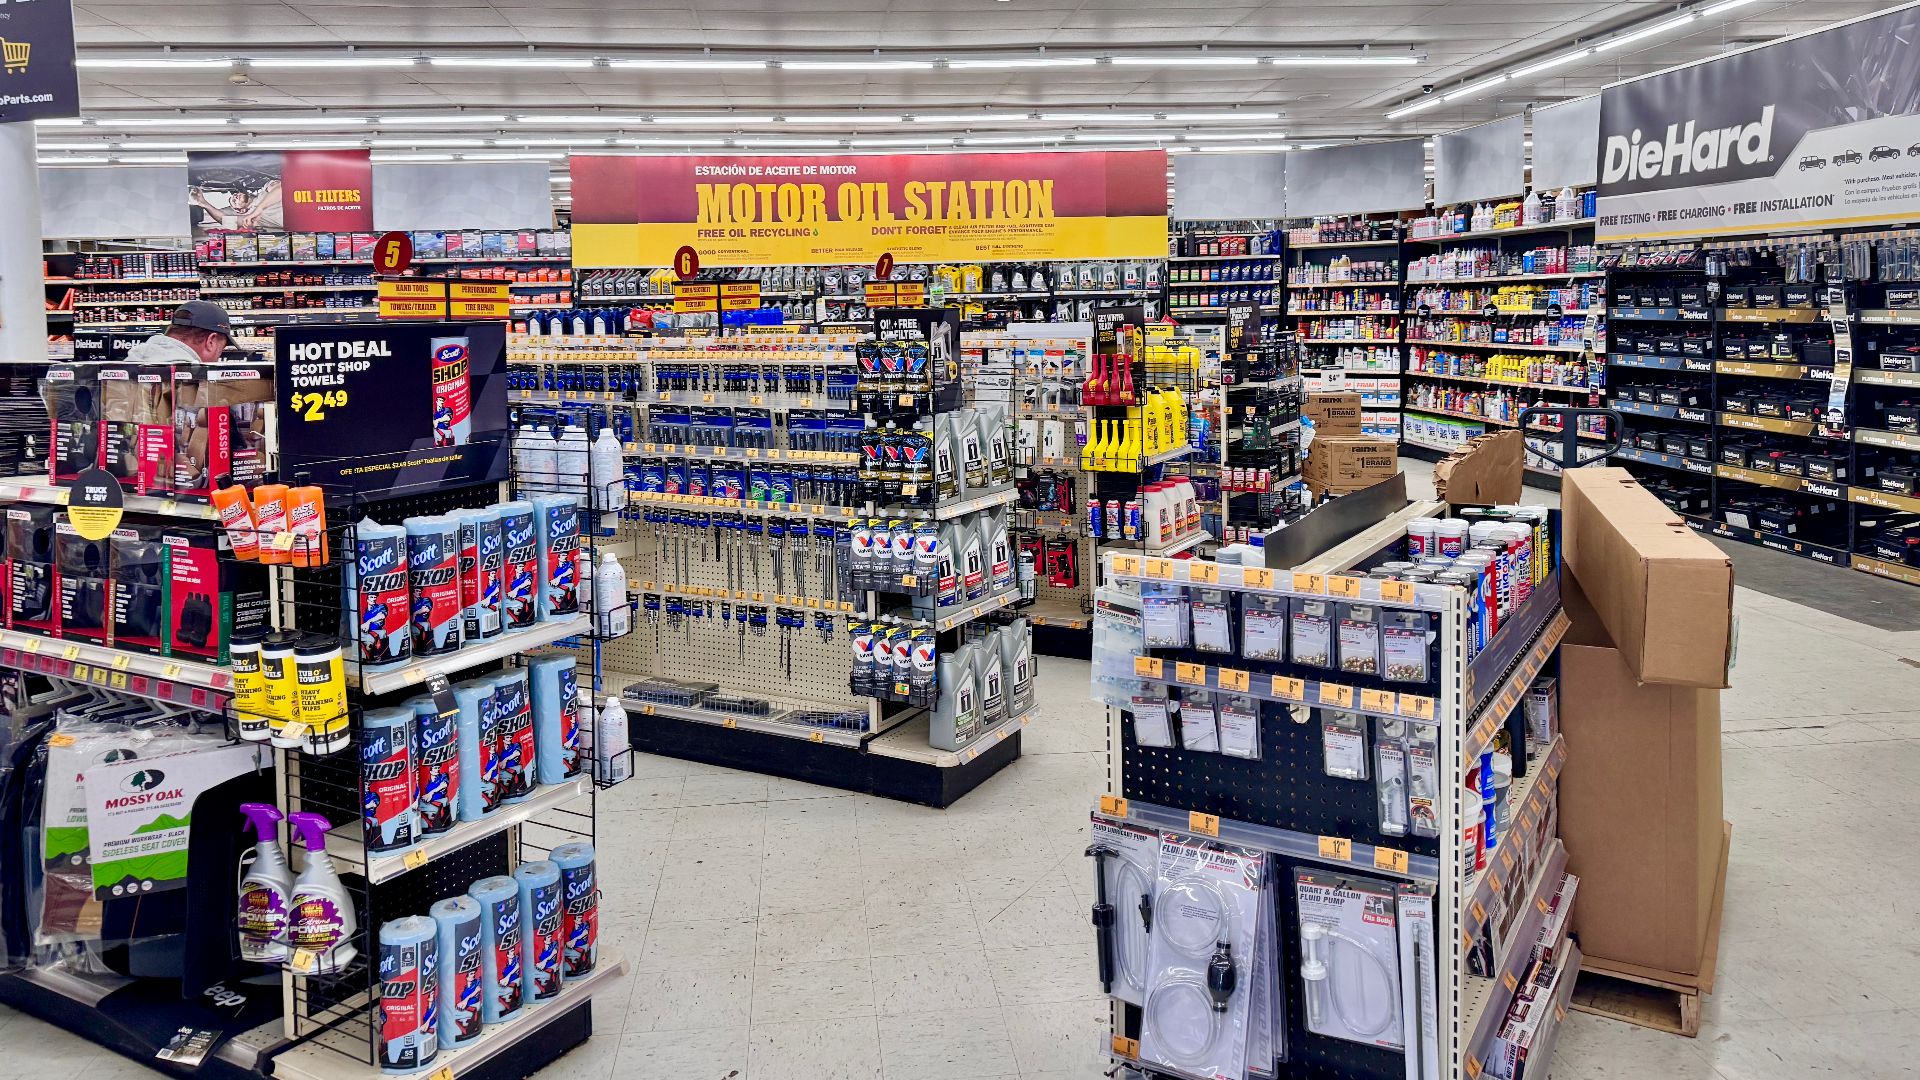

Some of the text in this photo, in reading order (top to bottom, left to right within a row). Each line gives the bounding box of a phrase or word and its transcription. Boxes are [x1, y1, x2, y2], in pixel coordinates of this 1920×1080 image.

[695, 164, 856, 176] ESTACIÓN DE ACEITE DE MOTOR
[294, 190, 360, 203] OIL FILTERS
[696, 179, 1055, 223] MOTOR OIL STATION
[1600, 215, 1618, 227] FREE
[1620, 212, 1651, 225] TESTING
[1657, 210, 1678, 222] FREE
[1679, 206, 1726, 220] CHARGING
[1734, 202, 1758, 215] FREE
[698, 228, 810, 238] FREE OIL RECYCLING
[872, 226, 948, 236] DON'T FORGET
[384, 240, 400, 268] 5
[682, 252, 691, 275] 6
[1890, 292, 1912, 300] DieHard
[75, 339, 102, 349] DieHard
[290, 340, 391, 361] HOT DEAL
[337, 362, 370, 372] SHOP
[1811, 370, 1833, 379] DieHa
[291, 374, 344, 388] TOWELS
[1888, 414, 1911, 423] DieHard
[219, 413, 228, 460] CLASSIC
[968, 444, 977, 460] 1
[1687, 463, 1712, 473] DieHard
[1882, 478, 1905, 488] DieHard
[1808, 484, 1839, 496] DieHard
[1812, 551, 1833, 562] DieHard
[1878, 546, 1900, 557] DieHard
[359, 546, 393, 576] Scott
[362, 571, 407, 593] SHOP
[410, 568, 455, 587] SHOP
[299, 674, 329, 683] TOWELS
[364, 737, 385, 758] cott
[105, 788, 183, 809] MOSSY OAK
[102, 837, 187, 857] SIDELESS SEAT COVER
[1215, 854, 1238, 866] PUMP
[1299, 886, 1323, 895] QUART
[1333, 890, 1361, 900] GALLON
[1300, 894, 1345, 905] FLUID PUMP
[289, 925, 340, 933] POWER
[204, 984, 246, 1007] eep
